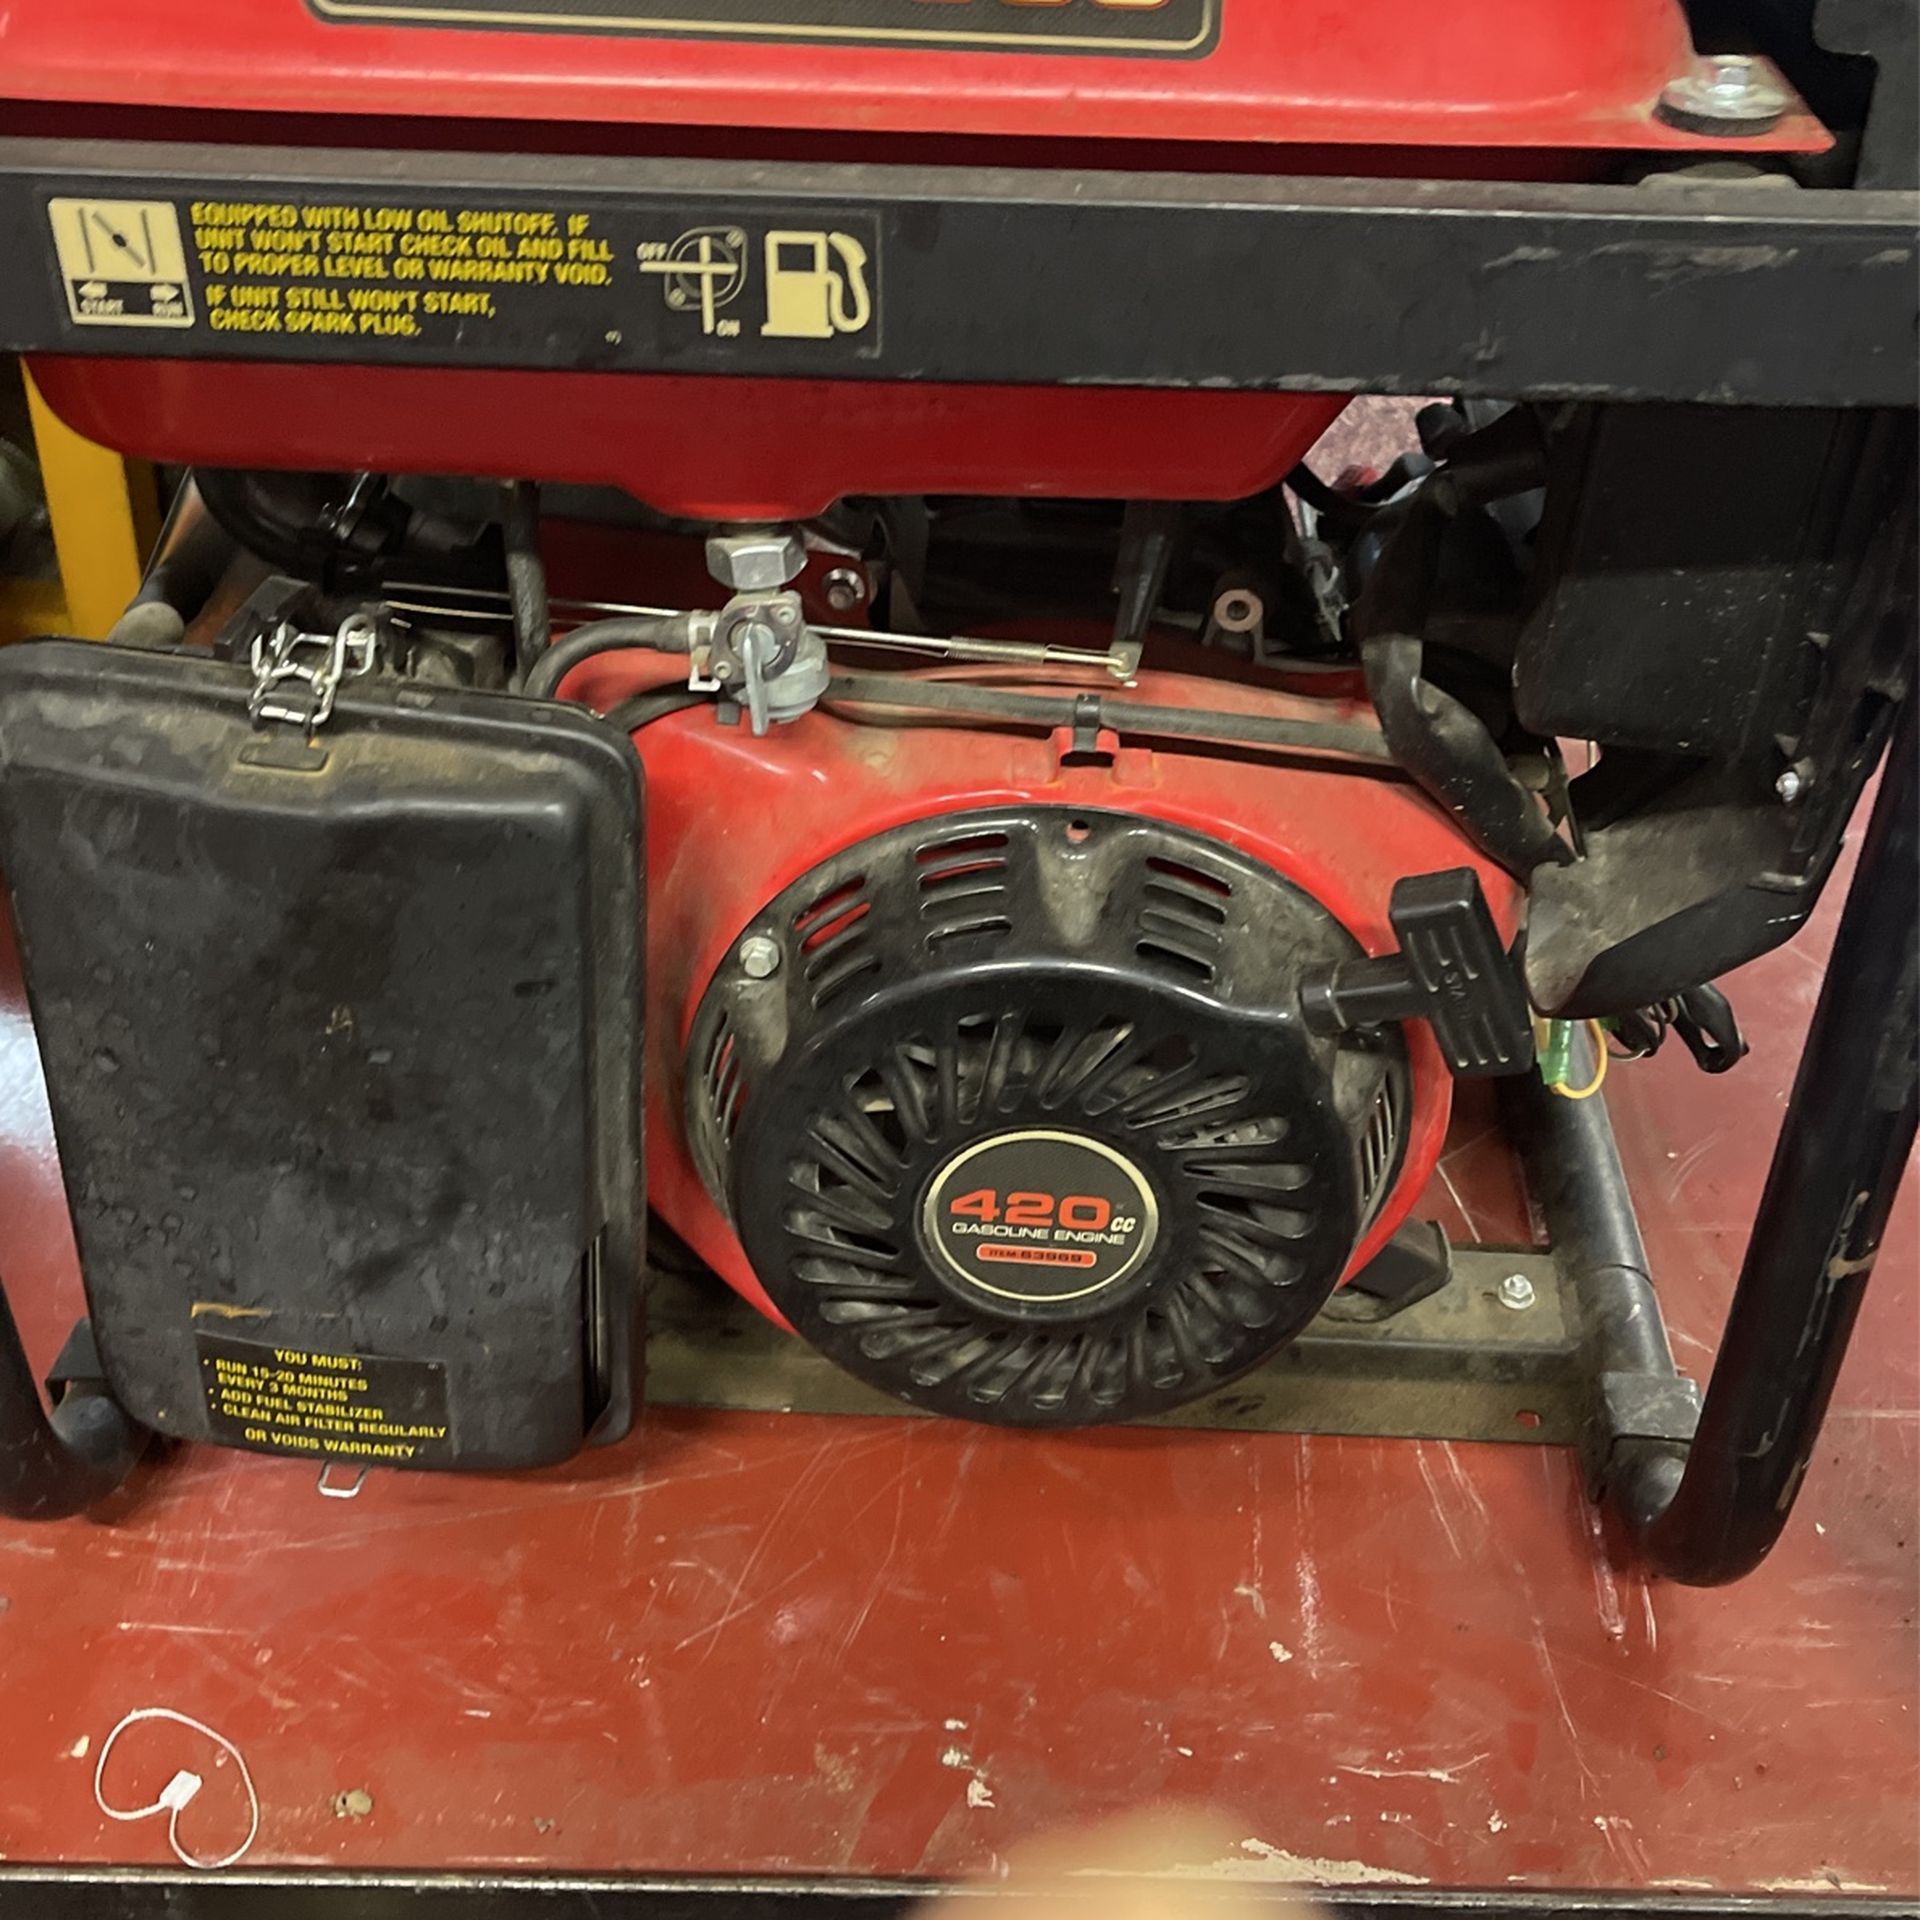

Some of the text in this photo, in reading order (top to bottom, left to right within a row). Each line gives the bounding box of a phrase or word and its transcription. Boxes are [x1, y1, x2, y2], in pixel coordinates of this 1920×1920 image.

[191, 202, 298, 228] EQUIPPED
[302, 206, 360, 229] WITH
[363, 207, 413, 231] LOW
[417, 209, 454, 232] OIL
[568, 213, 590, 236] IF
[195, 227, 615, 261] UNIT WON'T START CHECK OIL AND FILL
[199, 251, 230, 274] TO
[233, 252, 320, 276] PROPER
[323, 255, 389, 279] LEVEL
[394, 257, 424, 280] OR
[428, 259, 550, 283] WARRANTY
[205, 284, 227, 306] IF
[230, 285, 280, 308] UNIT
[285, 286, 346, 310] STILL
[348, 288, 419, 312] WON'T
[210, 308, 282, 332] CHECK
[284, 310, 357, 334] SPARK
[950, 1188, 1111, 1230] 420
[952, 1222, 1125, 1245] GASOLINE ENGINE
[988, 1248, 1017, 1257] ITEM
[274, 1348, 307, 1365] YOU
[216, 1359, 247, 1375] RUN
[299, 1372, 368, 1391] MINUTES
[218, 1371, 348, 1402] EVERY 3 MONTHS
[221, 1388, 383, 1420] ADD FUEL STABILIZER
[223, 1403, 446, 1438] CLEAN AIR FILTER REGULARLY
[245, 1427, 415, 1458] OR VOIDS WARRANTY
